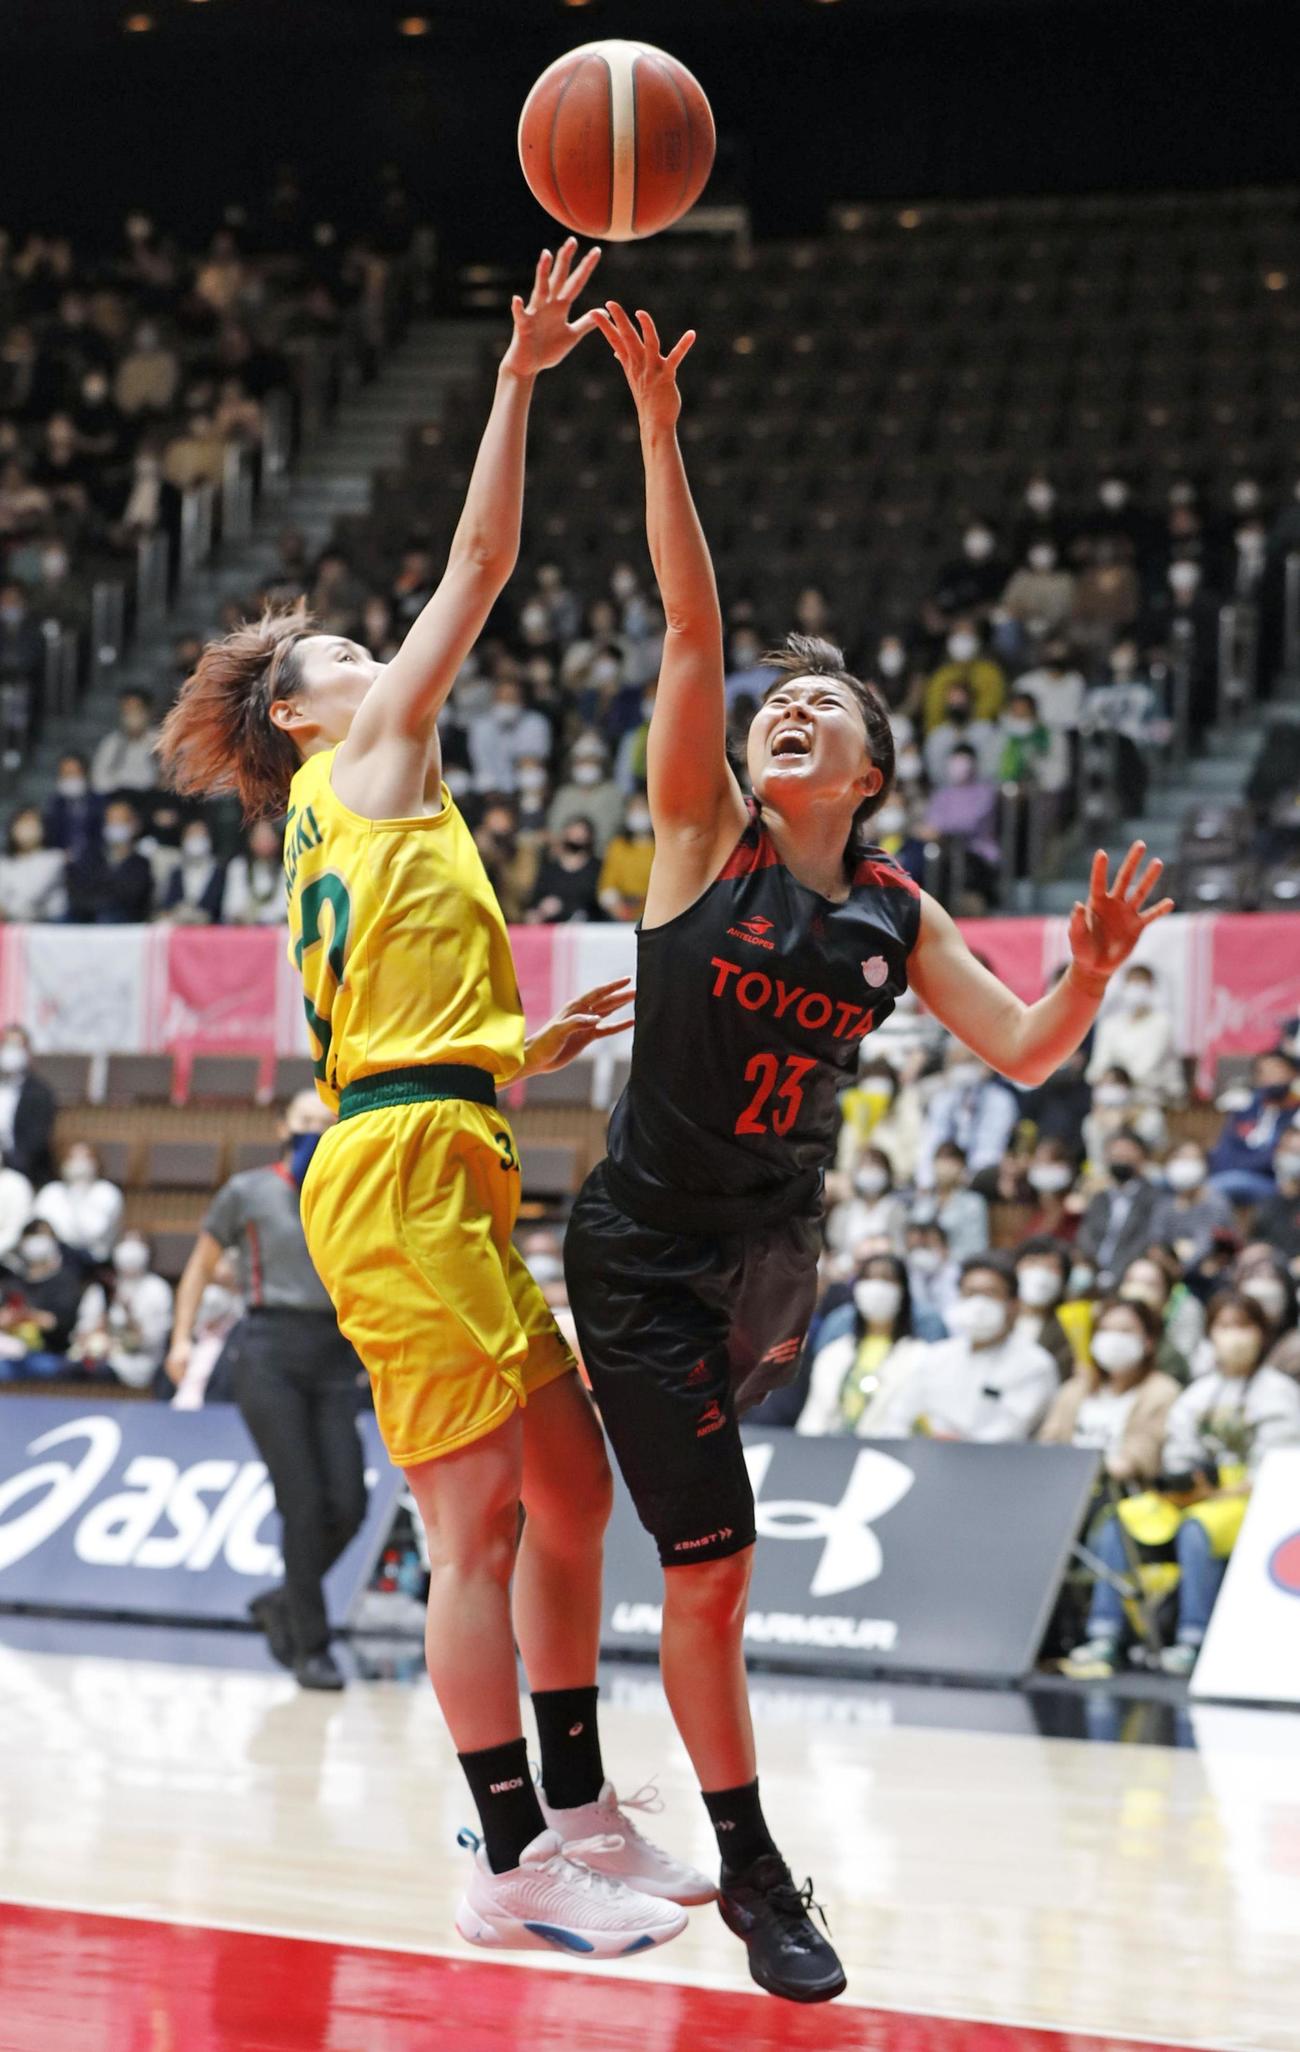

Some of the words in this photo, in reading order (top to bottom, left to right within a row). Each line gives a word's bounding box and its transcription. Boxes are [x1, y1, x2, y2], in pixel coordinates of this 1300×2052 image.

[726, 927, 775, 950] ANTELOPES
[711, 957, 875, 1040] TOYOTA
[734, 1053, 818, 1137] 23
[494, 1131, 520, 1172] 3
[74, 1456, 287, 1577] asic
[490, 1777, 523, 1794] ENEOS
